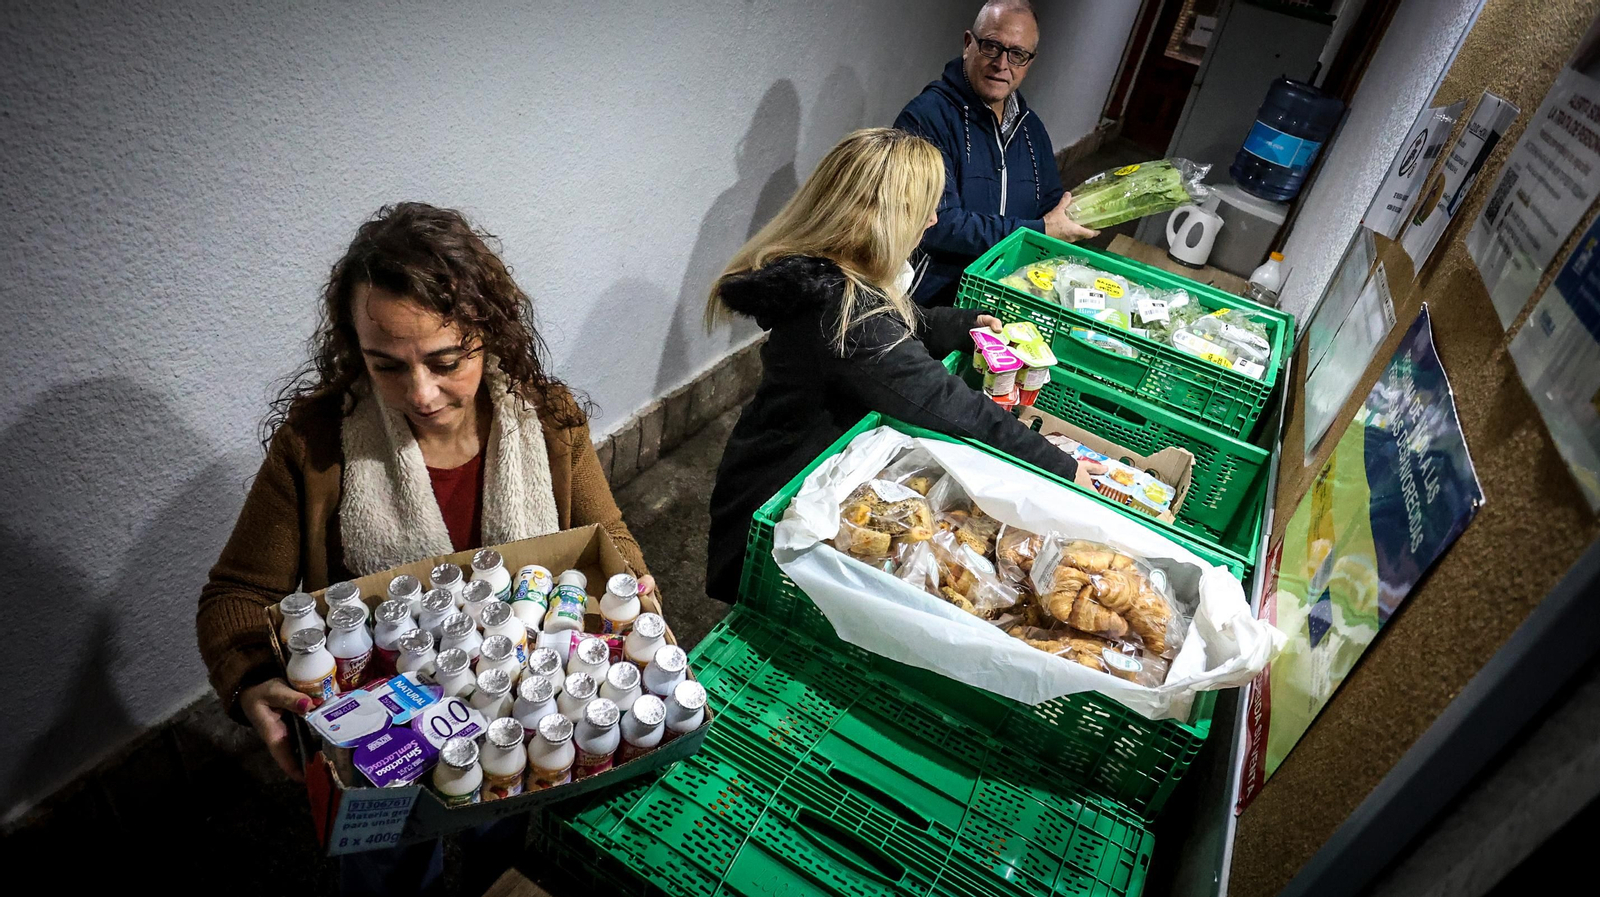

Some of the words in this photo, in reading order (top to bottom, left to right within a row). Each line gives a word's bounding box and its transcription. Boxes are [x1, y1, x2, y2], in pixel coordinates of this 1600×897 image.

[1420, 456, 1432, 476] A
[1397, 429, 1424, 554] DESFAVORECIDAS
[1424, 466, 1440, 504] LAS
[394, 680, 426, 706] NATURAL
[1246, 745, 1259, 799] VENTA
[342, 822, 368, 832] para
[371, 818, 402, 827] untar
[346, 810, 388, 820] Materia
[339, 837, 349, 848] 8
[352, 838, 361, 846] x
[366, 833, 401, 844] 400g
